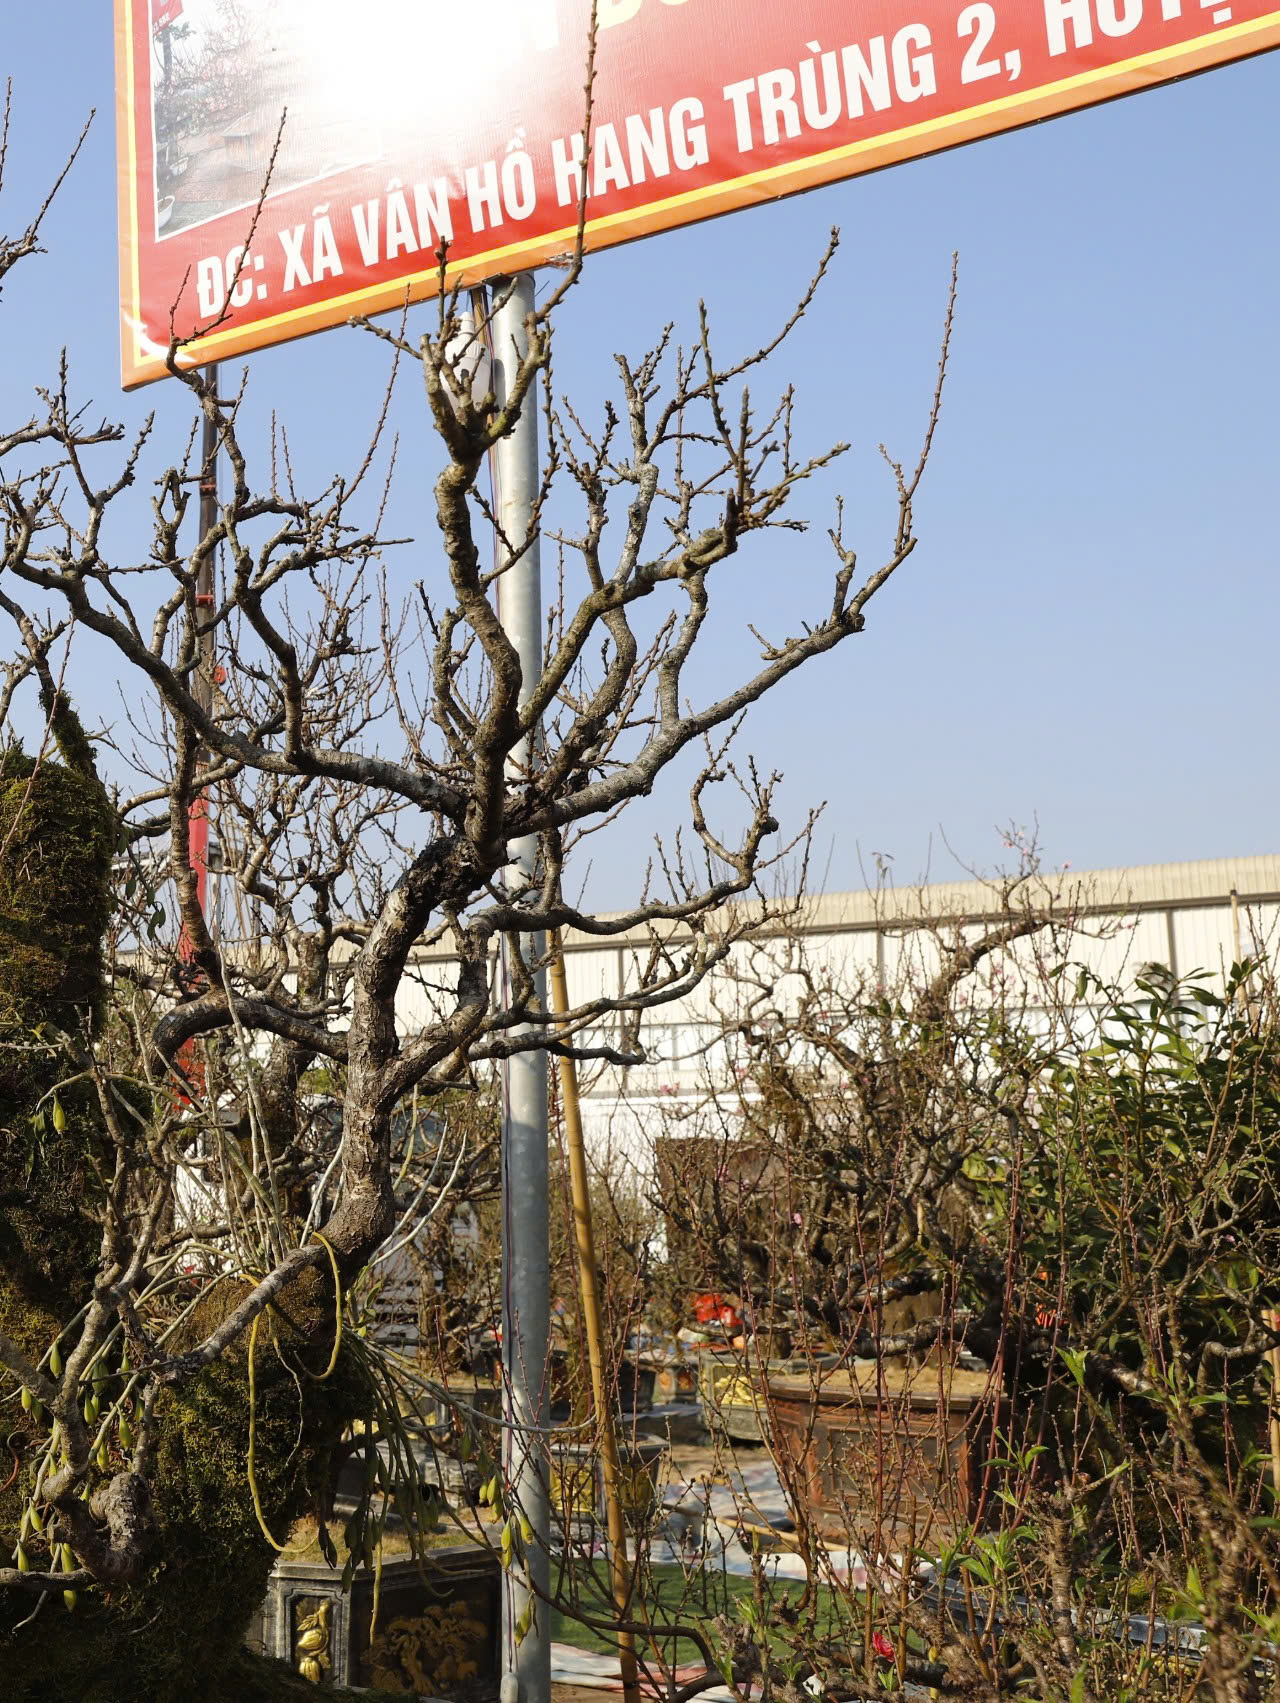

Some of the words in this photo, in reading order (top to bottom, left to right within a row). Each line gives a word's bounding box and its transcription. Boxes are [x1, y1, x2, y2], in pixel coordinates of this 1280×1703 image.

[197, 245, 268, 319] ĐC:
[277, 203, 344, 293] XÃ
[351, 176, 454, 267] VÂN
[552, 97, 710, 208] HANG
[723, 23, 938, 154] TRÙNG
[956, 2, 1022, 85] 2,
